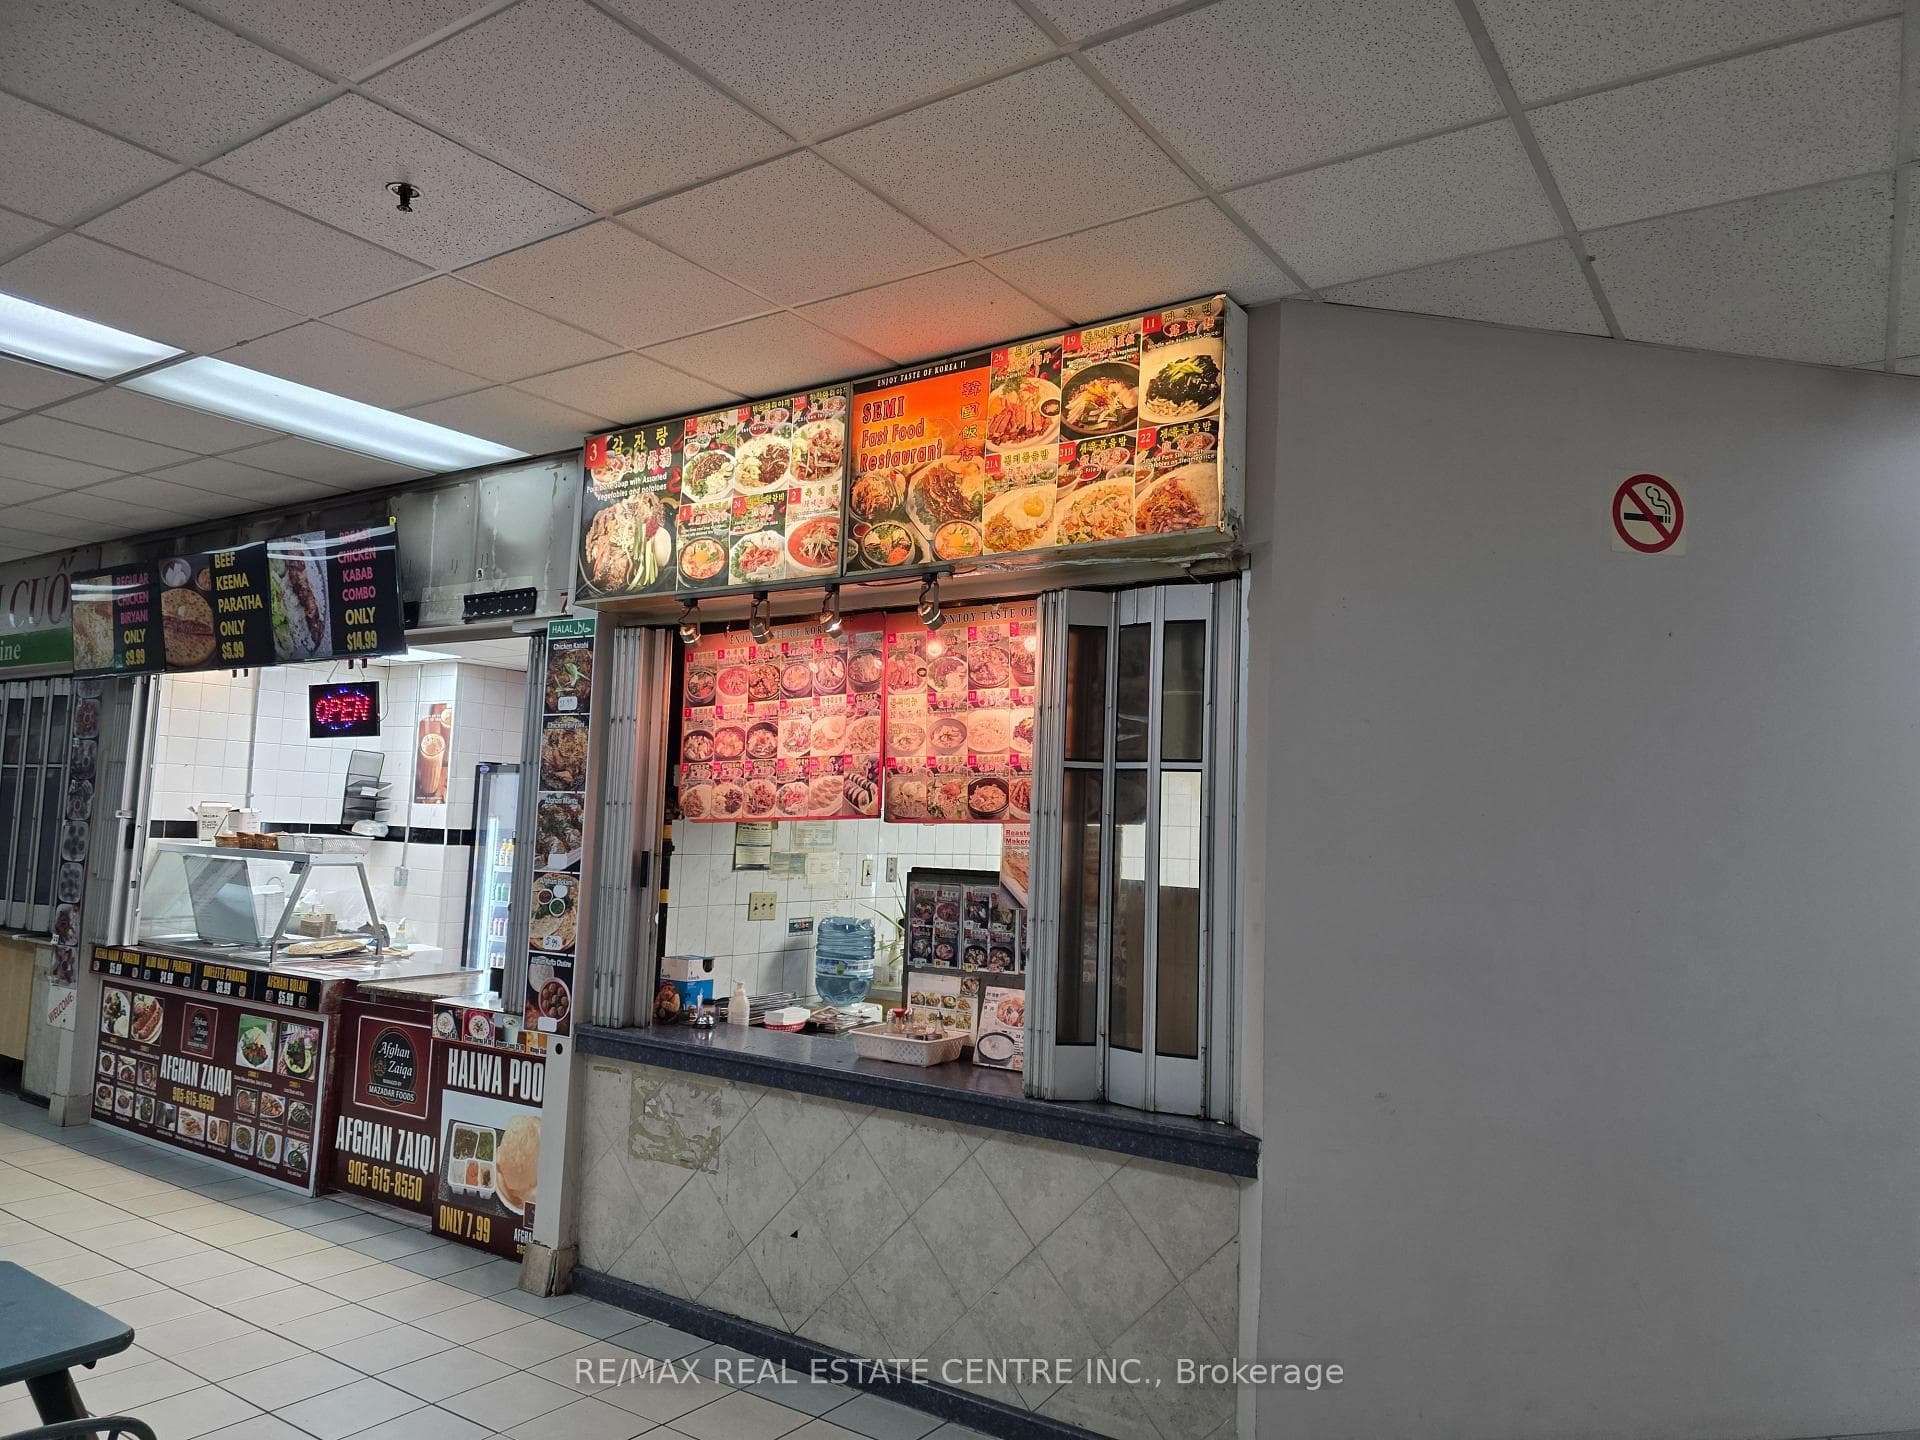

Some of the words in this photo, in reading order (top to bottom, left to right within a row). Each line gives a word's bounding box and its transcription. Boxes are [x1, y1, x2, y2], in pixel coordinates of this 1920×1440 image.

[1066, 335, 1076, 346] 19
[993, 353, 1004, 363] 26
[877, 375, 898, 387] ENJOY
[900, 370, 921, 382] TASTE
[923, 367, 934, 377] OF
[934, 361, 958, 375] KOREA
[862, 395, 905, 425] SEMI
[861, 425, 889, 449] Fast
[891, 417, 925, 443] Food
[1140, 432, 1151, 444] 22
[589, 443, 598, 461] 3
[859, 438, 943, 474] Restaurant
[215, 551, 237, 569] BEEF
[337, 547, 377, 564] CHICKEN
[215, 572, 250, 592] KEEMA
[342, 566, 374, 583] KABAB
[117, 591, 150, 607] CHICKEN
[341, 585, 377, 602] COMBO
[218, 594, 264, 614] PARATHA
[120, 609, 150, 625] BIRYANI
[345, 606, 377, 626] ONLY
[982, 607, 1016, 621] TASTE
[1020, 606, 1035, 617] OF
[123, 628, 147, 645] ONLY
[220, 619, 246, 637] ONLY
[551, 624, 573, 634] HALAL
[345, 629, 379, 652] $14.99
[553, 643, 573, 651] Chicken
[221, 640, 245, 661] $5.99
[315, 695, 370, 724] OPEN
[48, 991, 75, 1023] WELCOME
[378, 1041, 410, 1059] Afghan
[160, 1054, 200, 1088] AFGHAN
[200, 1063, 233, 1097] ZAIQA
[388, 1060, 413, 1079] Zaiqa
[447, 1047, 503, 1096] HALWA
[509, 1058, 546, 1103] POO
[368, 1084, 396, 1098] MAZADAR
[395, 1090, 415, 1102] FOODS
[335, 1115, 393, 1163] AFGHAN
[347, 1159, 423, 1203] 905-615-8550
[439, 1205, 465, 1236] ONLY
[466, 1211, 491, 1244] 7.99
